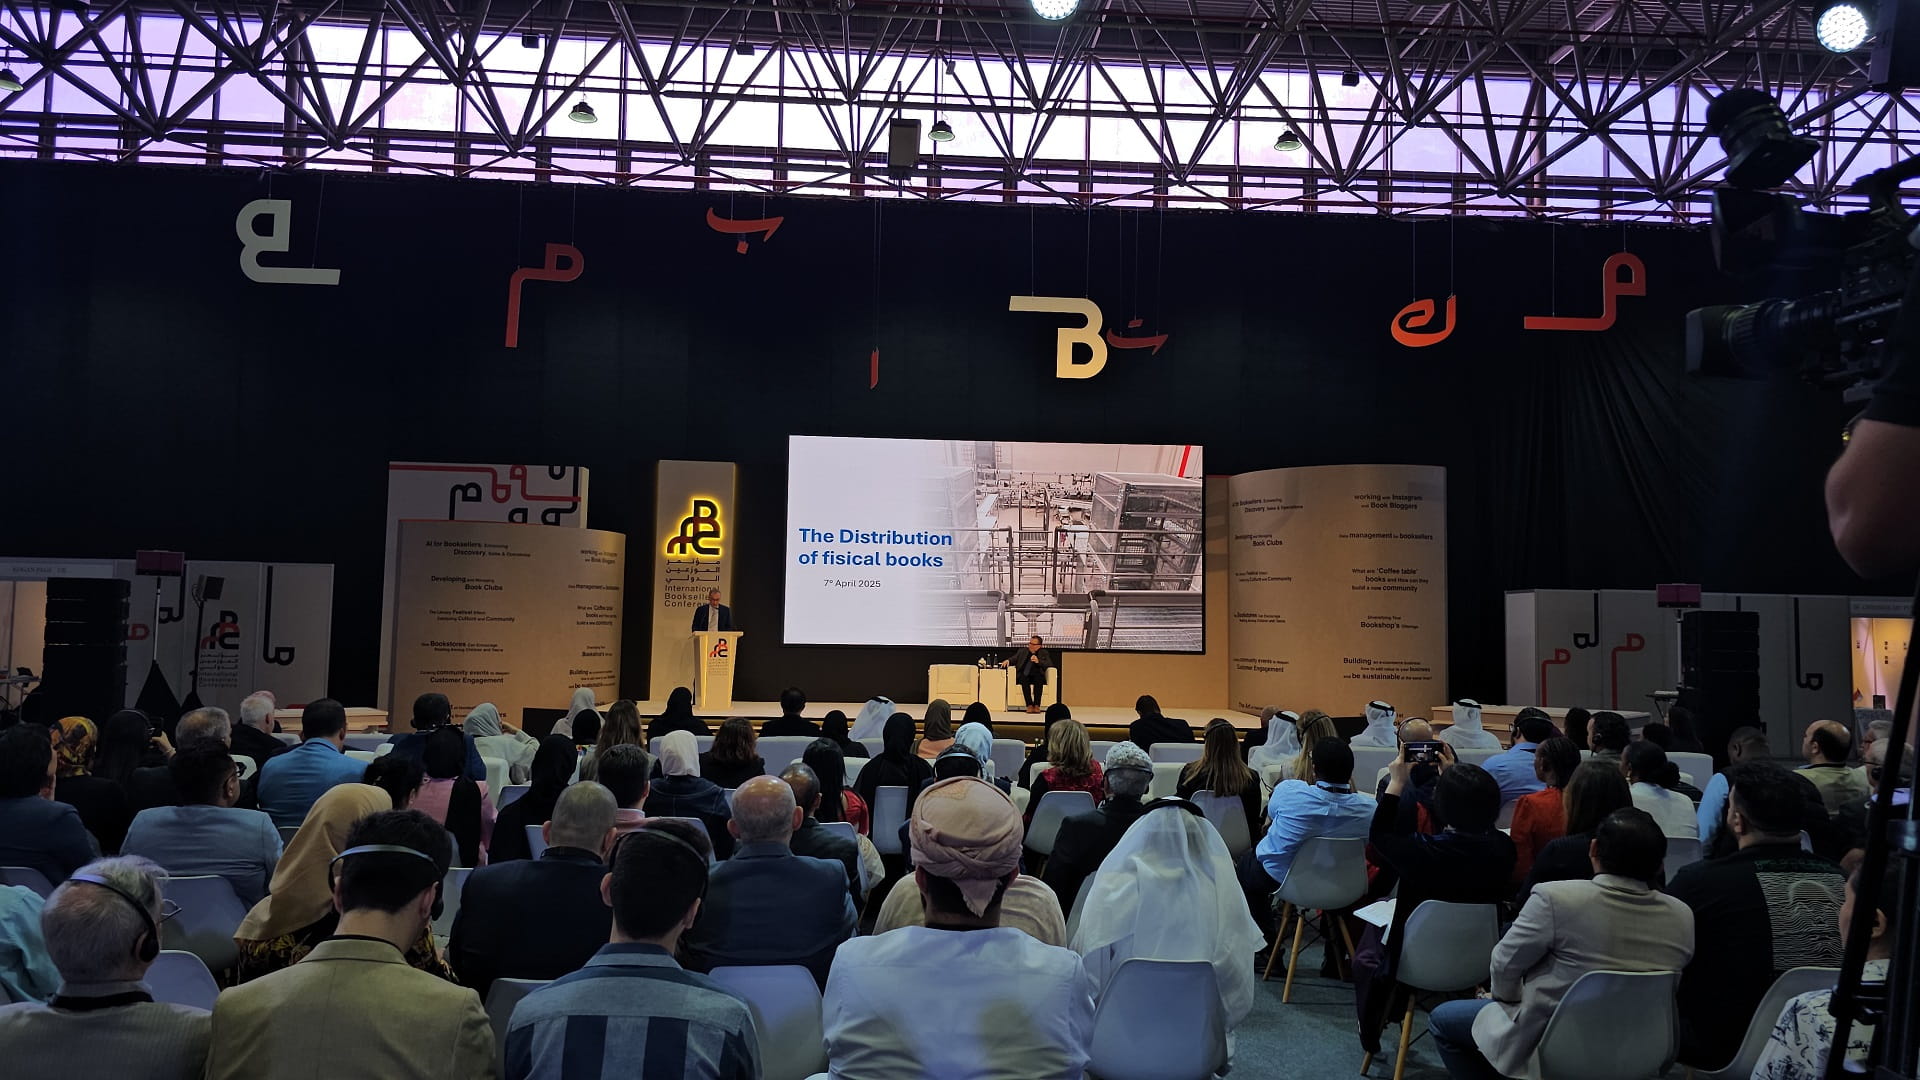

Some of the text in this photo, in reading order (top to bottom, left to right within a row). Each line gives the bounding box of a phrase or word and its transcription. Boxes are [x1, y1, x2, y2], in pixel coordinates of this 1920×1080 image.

[1391, 494, 1423, 502] Instagram
[1389, 502, 1418, 510] Bloggers
[798, 528, 953, 546] The Distribution
[798, 550, 943, 567] of fisical books
[835, 579, 856, 588] April
[858, 580, 881, 588] 2025
[1360, 621, 1400, 629] Bookshop's
[1343, 657, 1371, 665] Building
[1253, 665, 1284, 673] Engagement
